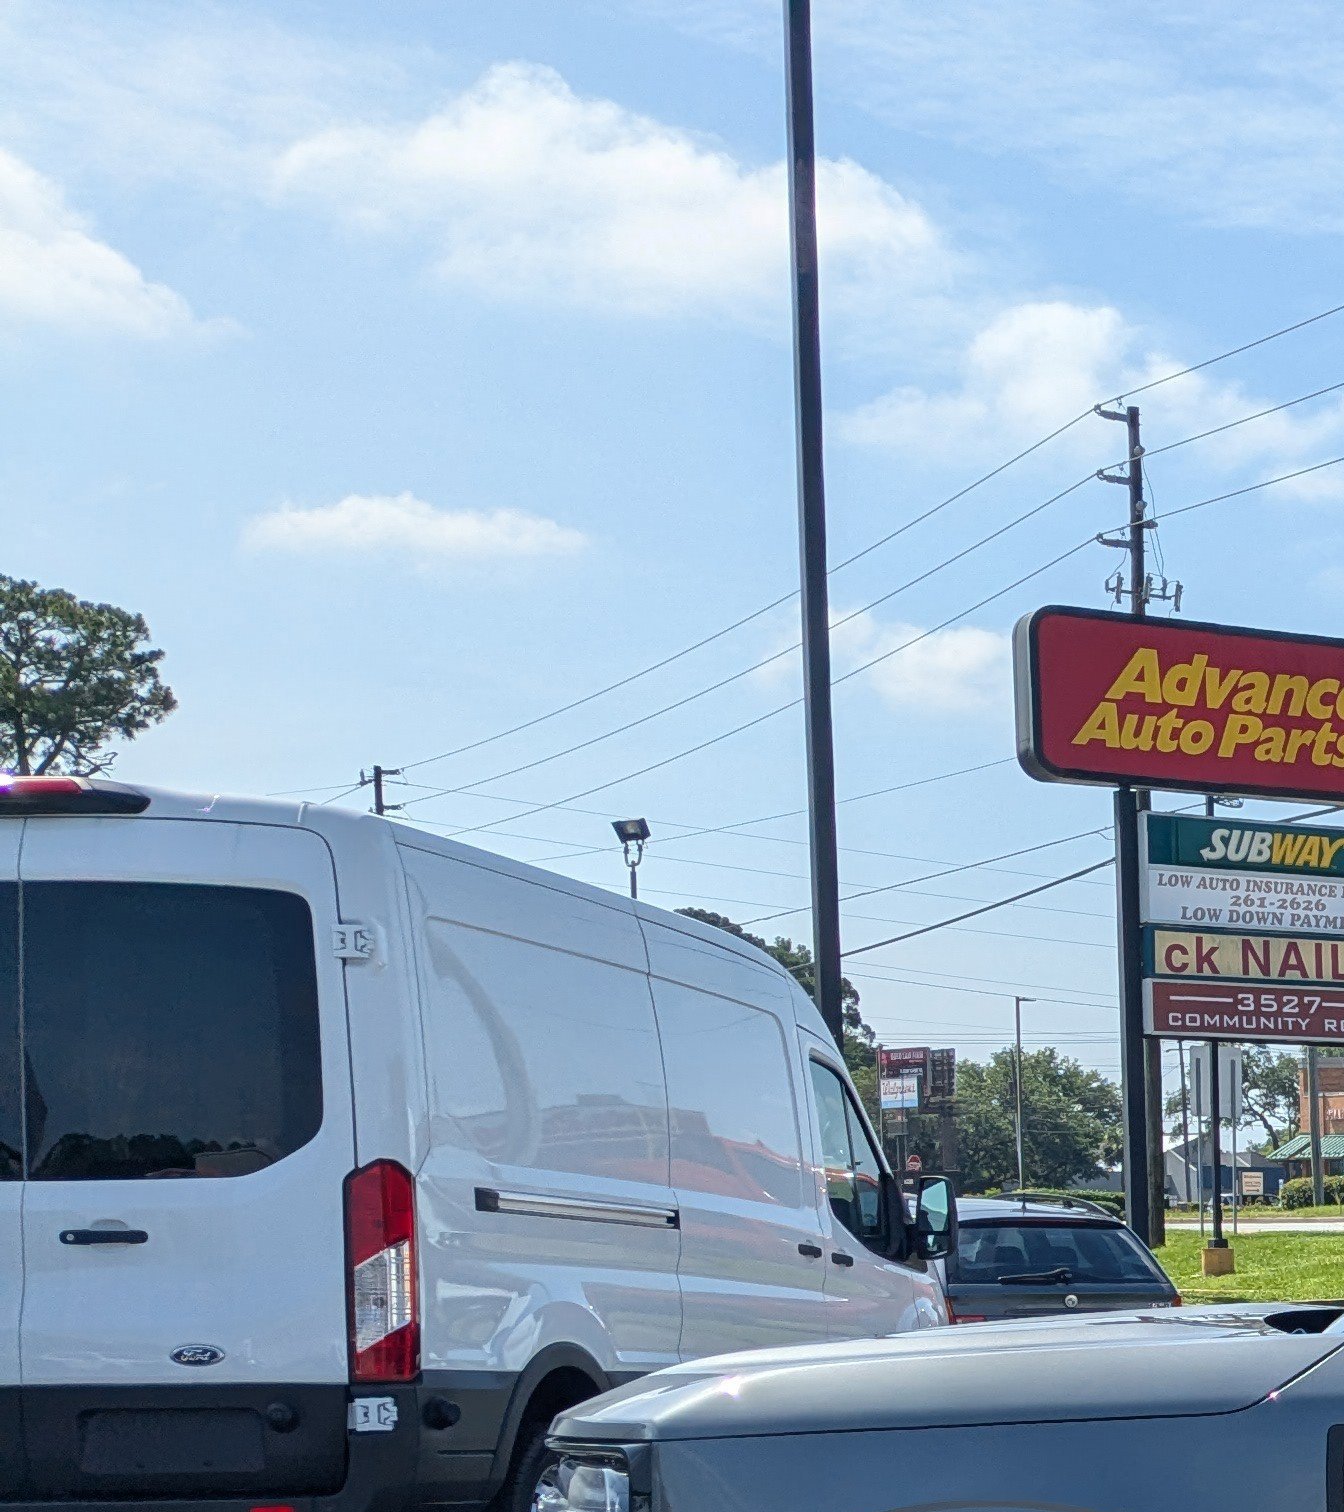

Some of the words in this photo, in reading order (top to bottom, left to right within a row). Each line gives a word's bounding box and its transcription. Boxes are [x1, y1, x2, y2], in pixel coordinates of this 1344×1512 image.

[1070, 701, 1215, 755] Auto
[1157, 873, 1193, 888] LOW
[1196, 875, 1241, 892] AUTO
[1244, 879, 1338, 899] INSURANCE
[1229, 894, 1327, 912] 261-2626
[1180, 905, 1223, 923] LOW
[1227, 909, 1286, 926] DOWN
[1237, 993, 1322, 1014] 3527
[1168, 1012, 1311, 1031] COMMUNITY
